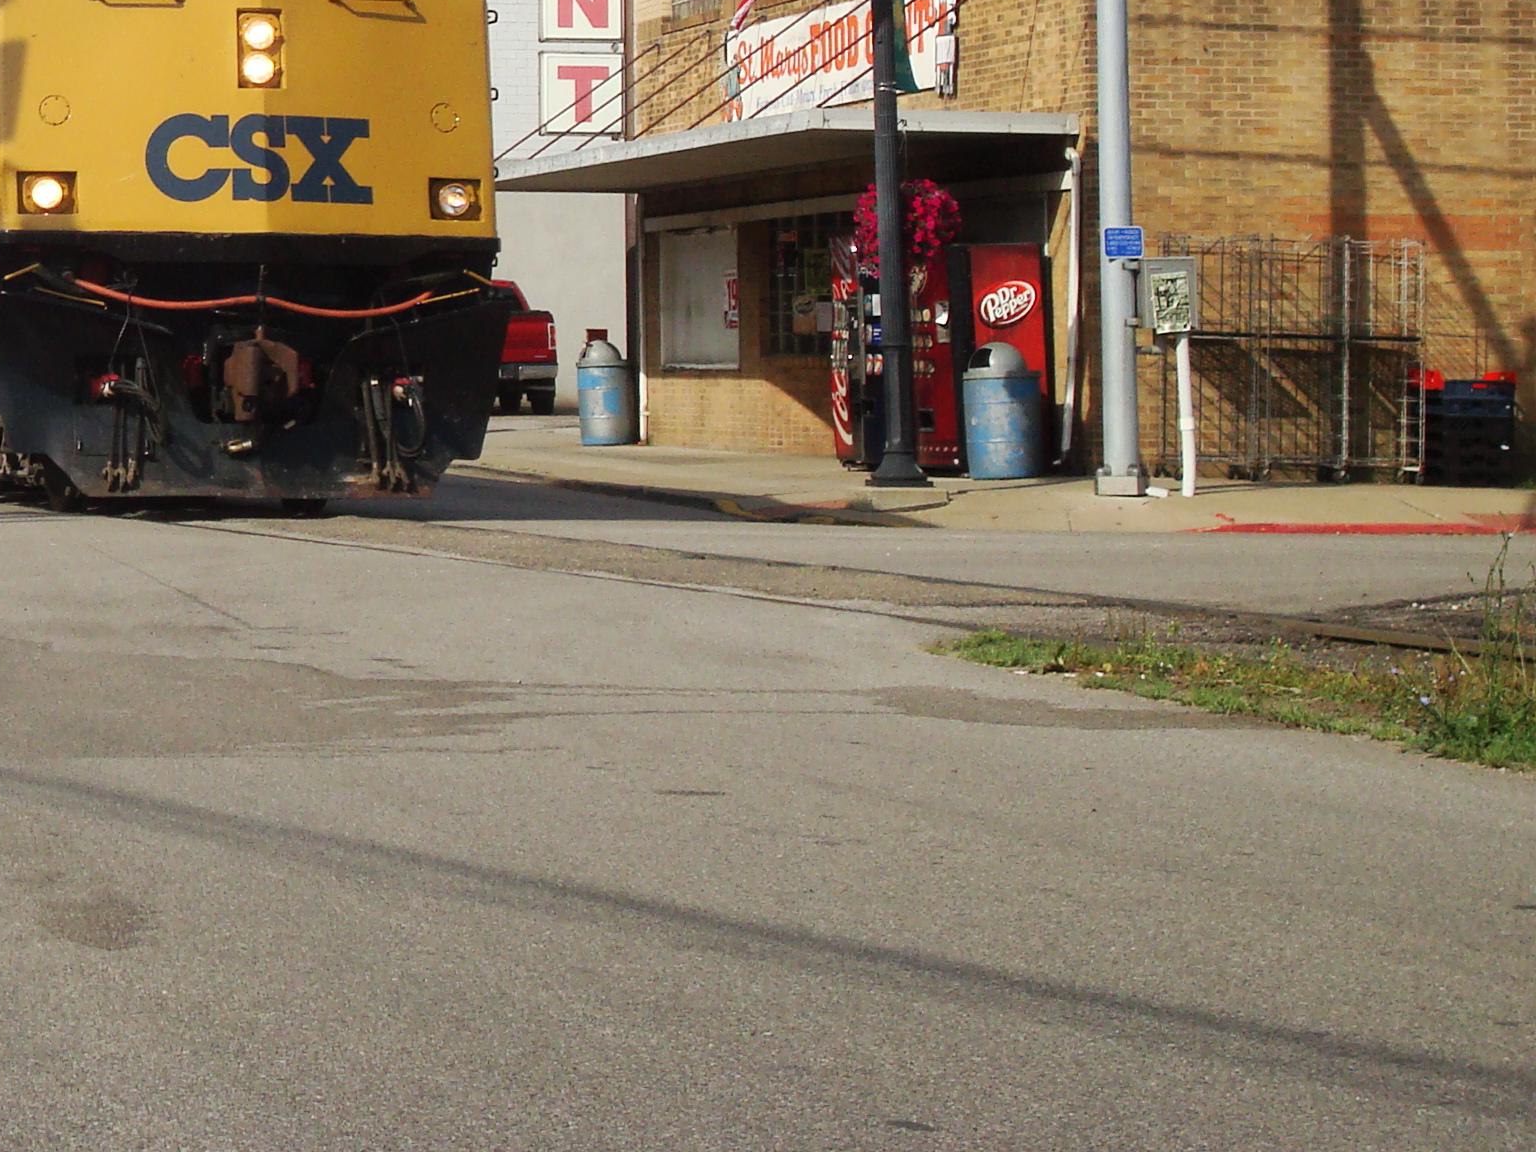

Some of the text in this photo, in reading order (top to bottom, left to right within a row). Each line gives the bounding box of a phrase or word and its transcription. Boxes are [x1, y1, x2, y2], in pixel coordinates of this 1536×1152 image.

[809, 14, 859, 74] FOOD
[145, 113, 374, 205] CSX
[984, 289, 1031, 323] Pepper
[997, 286, 1018, 304] Dr
